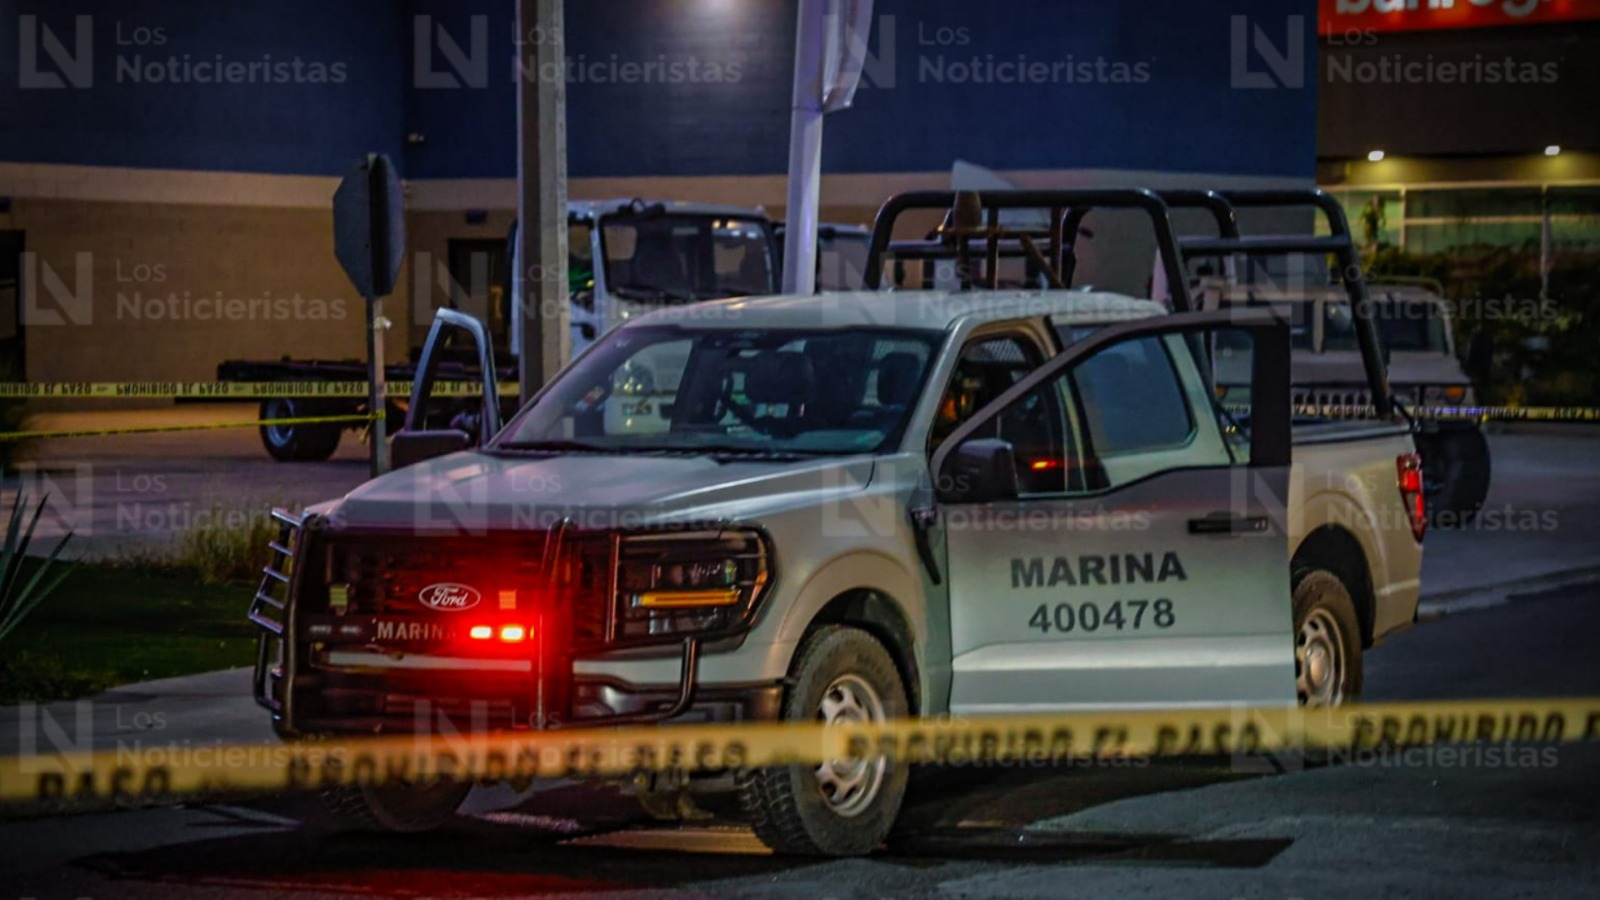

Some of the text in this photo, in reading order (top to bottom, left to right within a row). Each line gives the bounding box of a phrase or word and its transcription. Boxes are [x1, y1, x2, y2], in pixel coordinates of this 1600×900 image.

[1010, 552, 1188, 588] MARINA
[429, 585, 469, 608] Ford
[1028, 598, 1176, 634] 400478
[1155, 720, 1262, 755] PASO
